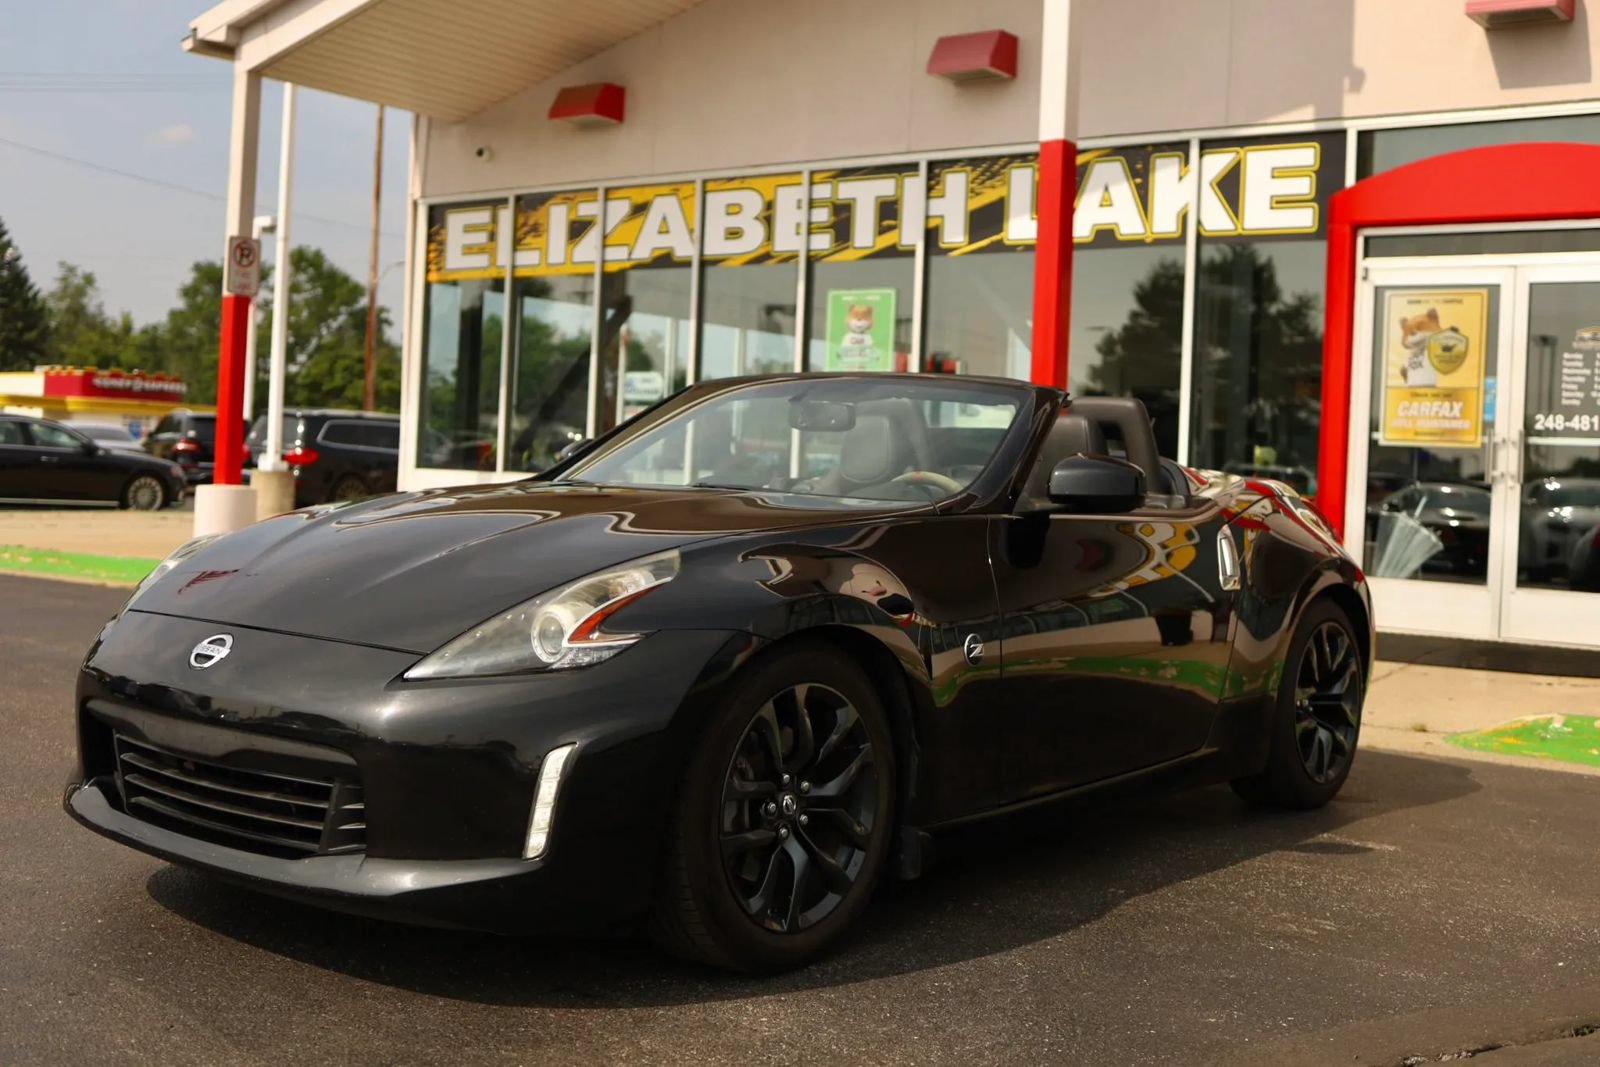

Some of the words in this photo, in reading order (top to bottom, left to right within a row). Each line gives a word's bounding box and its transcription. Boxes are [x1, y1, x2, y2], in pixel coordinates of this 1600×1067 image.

[444, 168, 969, 271] ELIZABETH
[1004, 142, 1321, 246] LAKE
[1397, 400, 1464, 419] CARFAX
